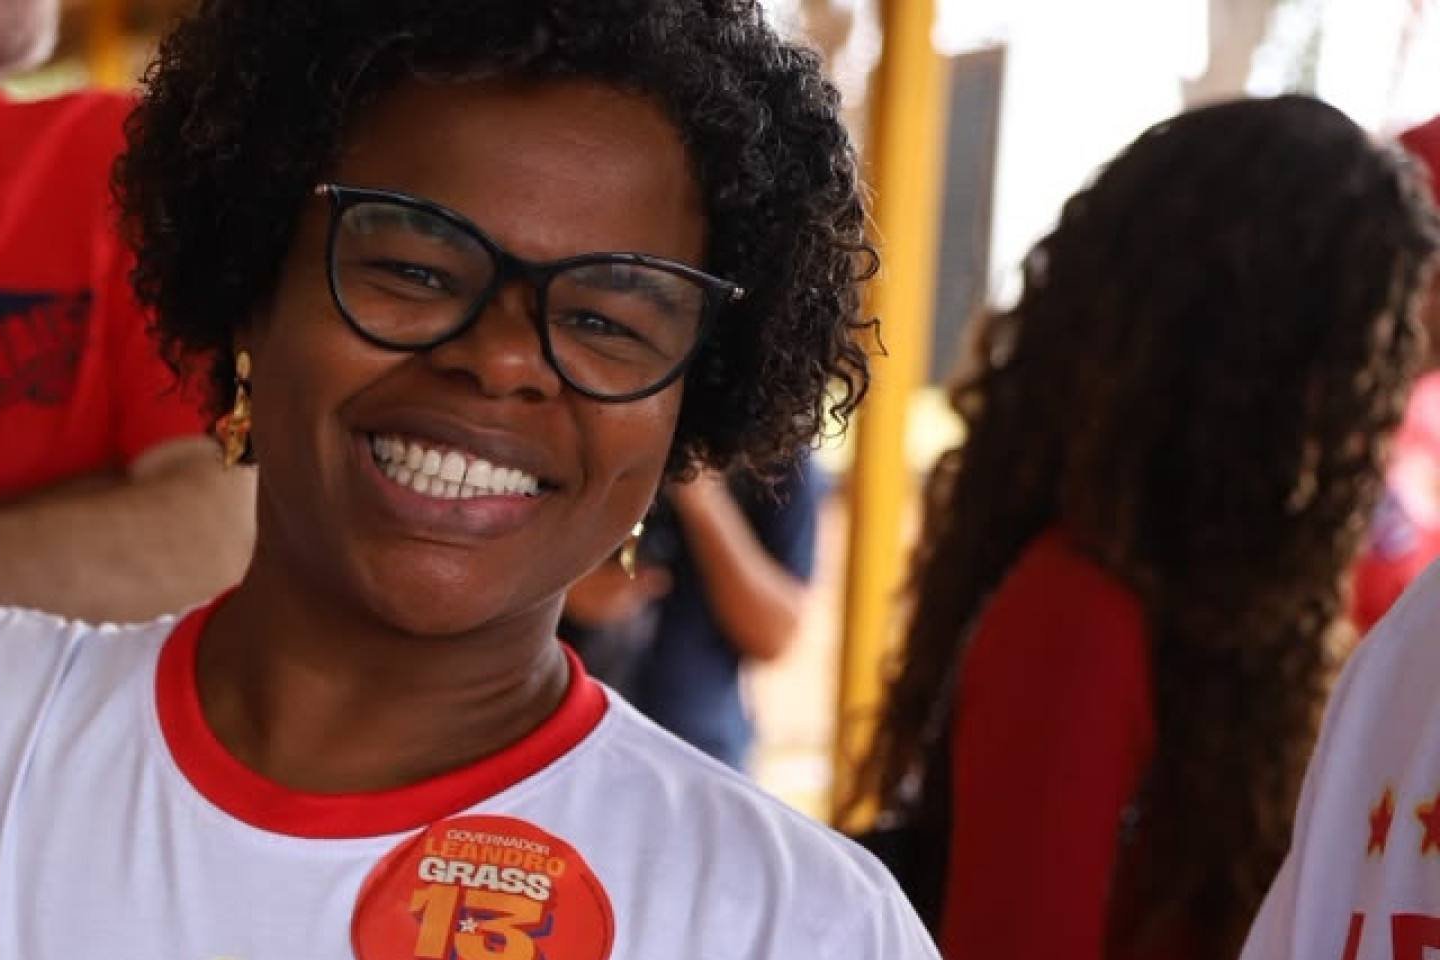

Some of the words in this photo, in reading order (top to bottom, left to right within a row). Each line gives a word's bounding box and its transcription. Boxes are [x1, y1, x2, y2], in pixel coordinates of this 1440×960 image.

[424, 836, 567, 876] LEANDRO
[447, 829, 550, 855] GOVERNADOR
[418, 855, 552, 902] GRASS
